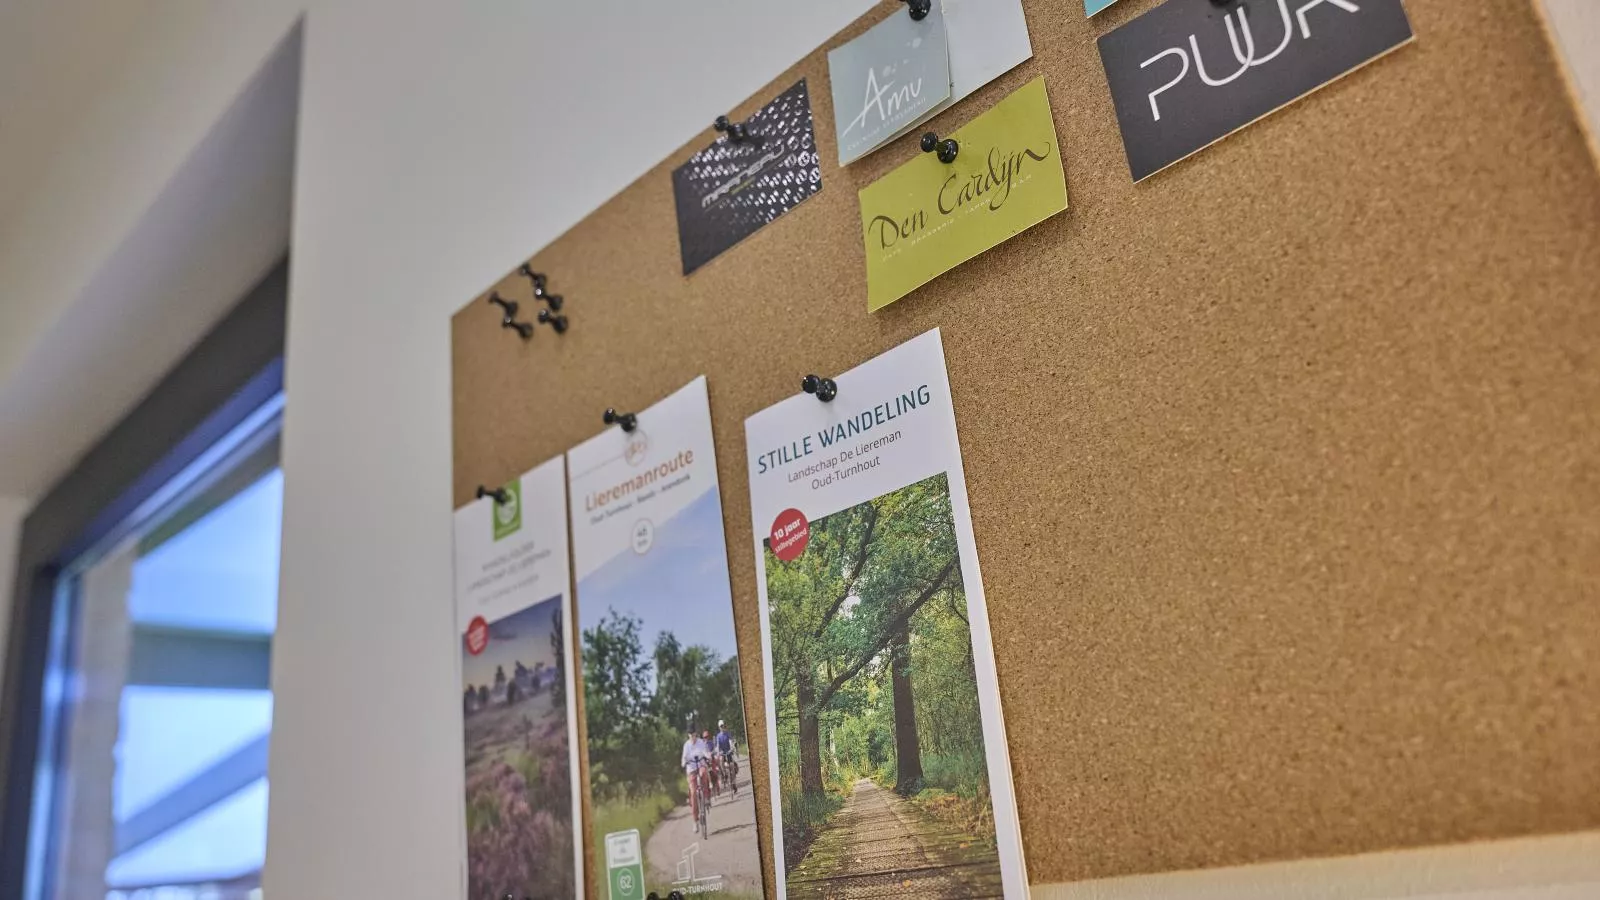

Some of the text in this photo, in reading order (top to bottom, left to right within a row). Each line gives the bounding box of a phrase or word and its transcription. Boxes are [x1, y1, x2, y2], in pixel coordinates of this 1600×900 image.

[868, 208, 929, 250] Den
[937, 141, 1051, 211] Cardijn
[757, 384, 931, 475] STILLE WANDELING
[787, 429, 902, 483] Landschap De Liereman
[585, 449, 694, 512] Lieremanroute
[811, 455, 881, 490] Oud-Turnhout
[774, 518, 801, 540] 10 jaar
[620, 875, 632, 889] 62
